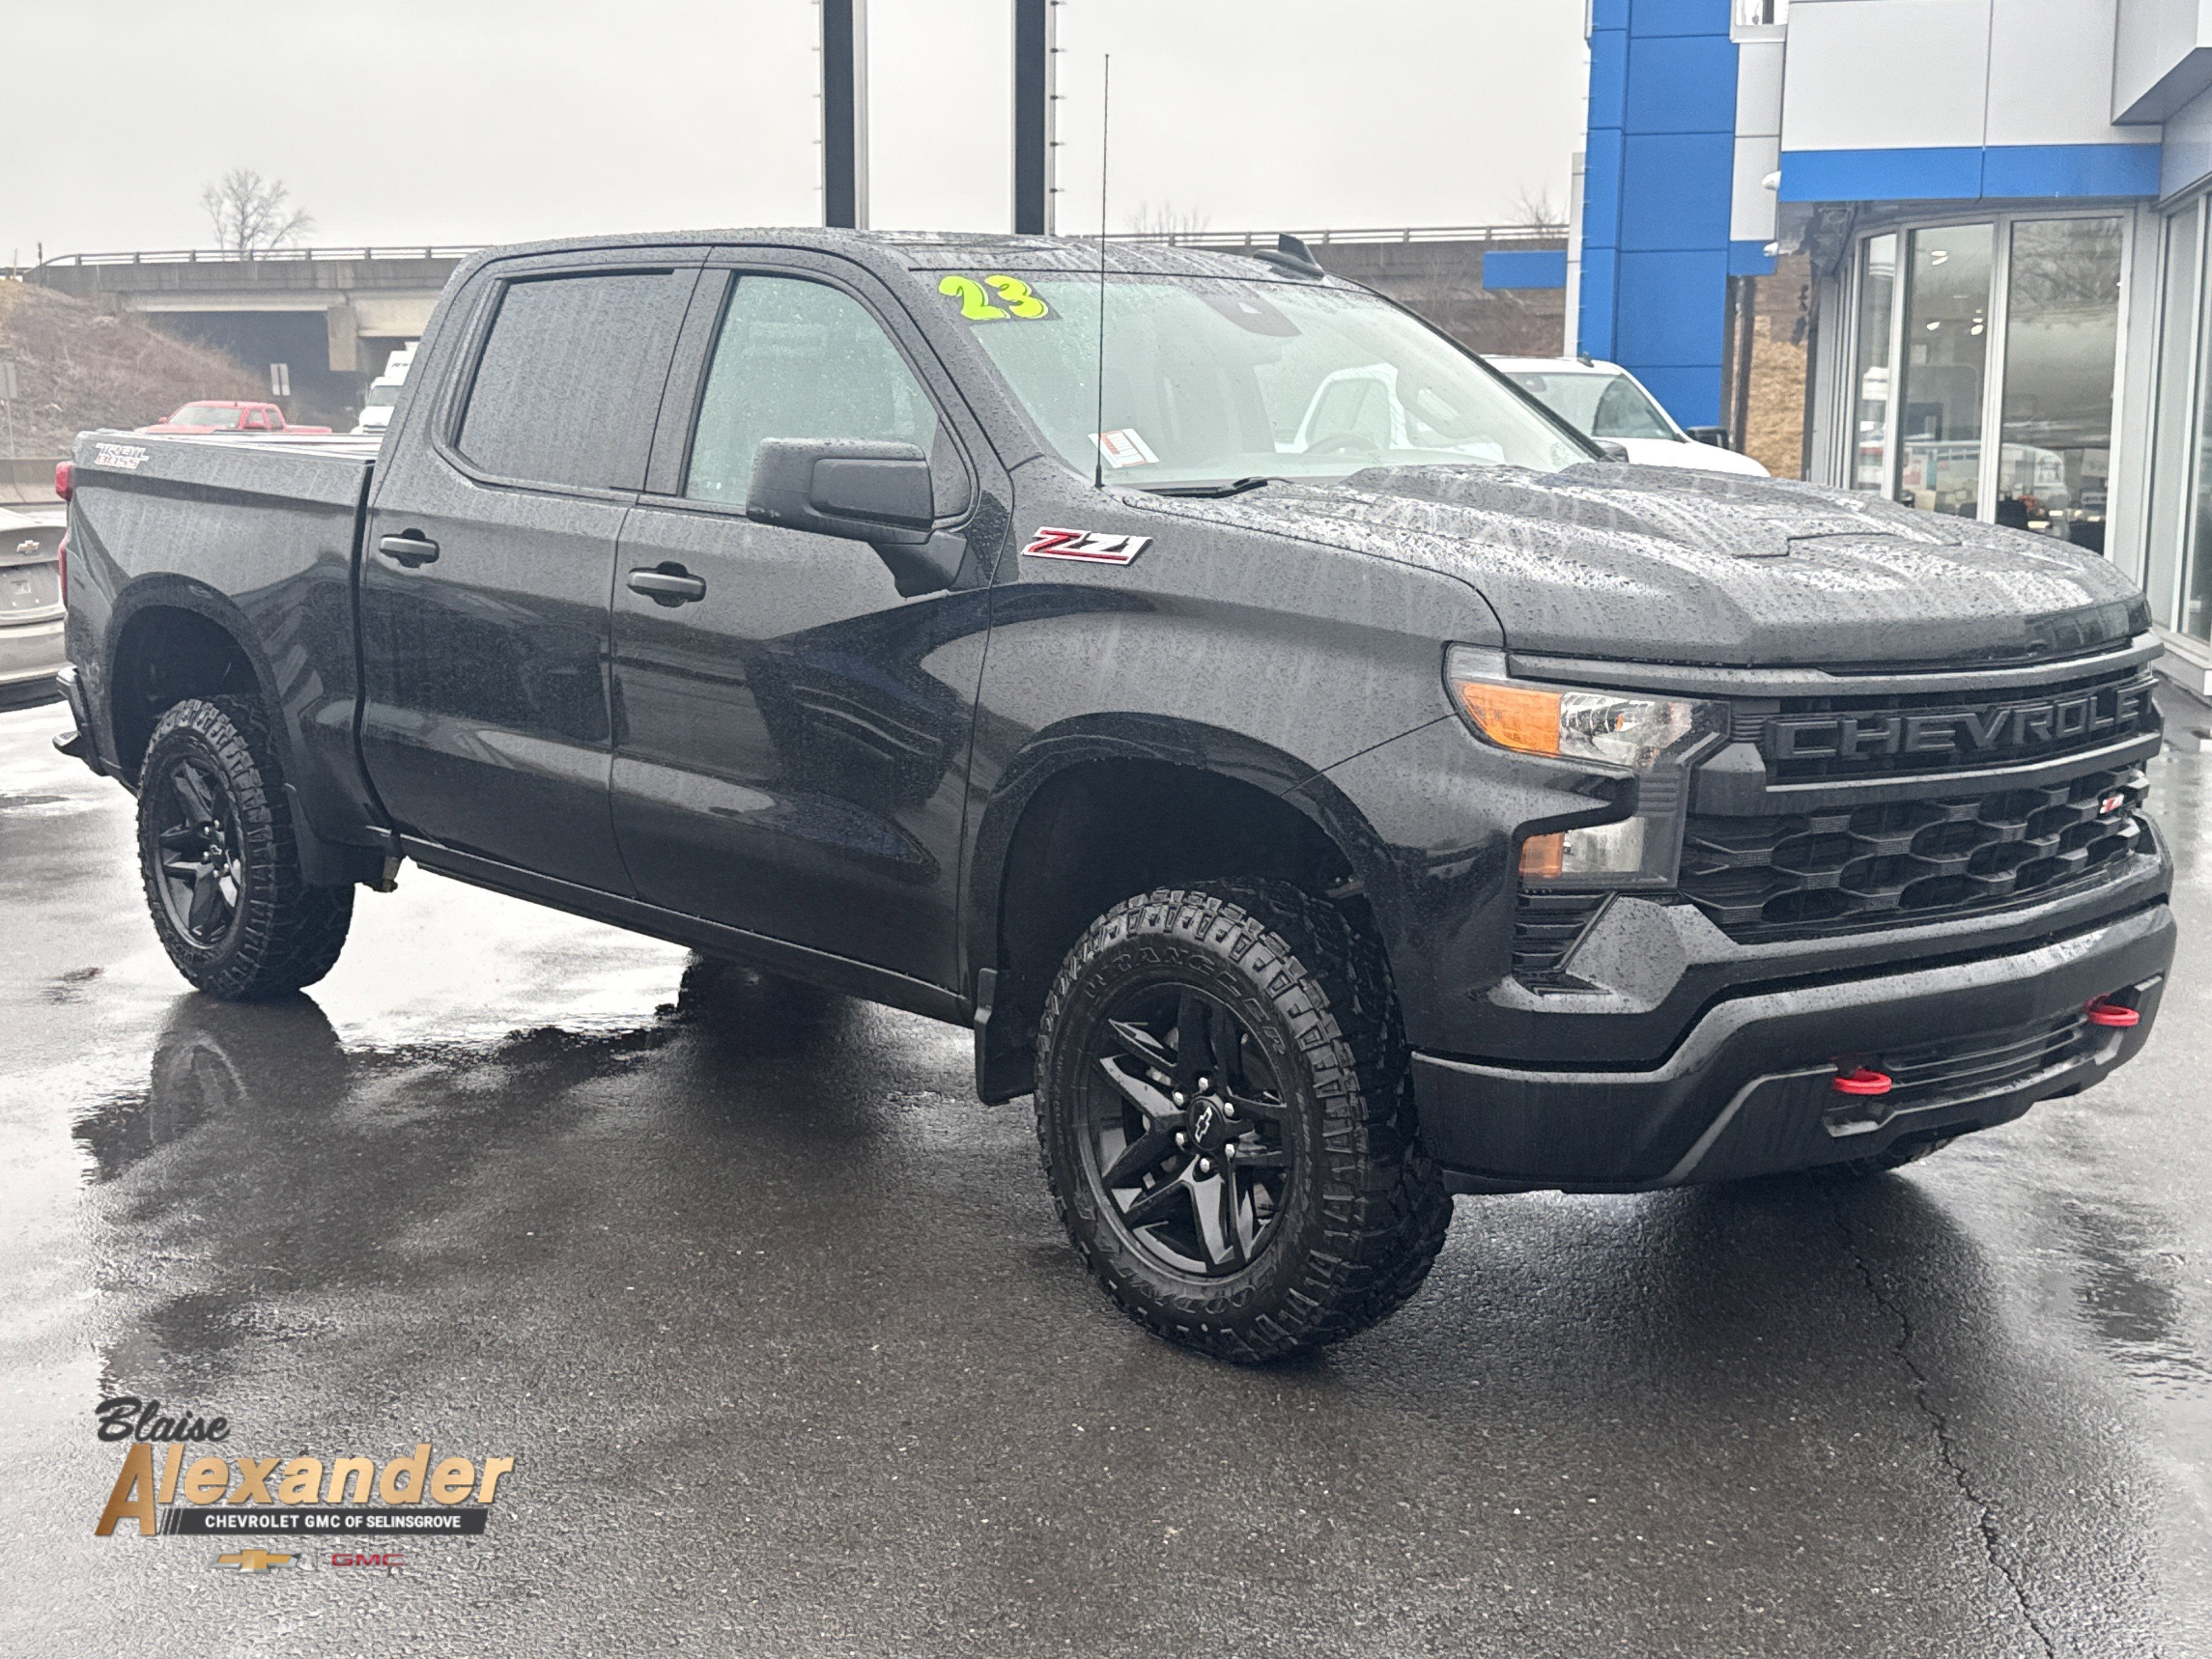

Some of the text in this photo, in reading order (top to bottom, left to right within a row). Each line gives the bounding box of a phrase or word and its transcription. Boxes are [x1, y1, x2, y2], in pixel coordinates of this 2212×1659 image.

[938, 274, 1048, 320] 23
[1020, 526, 1153, 565] Z71
[1767, 679, 2159, 759] CHEVROLET
